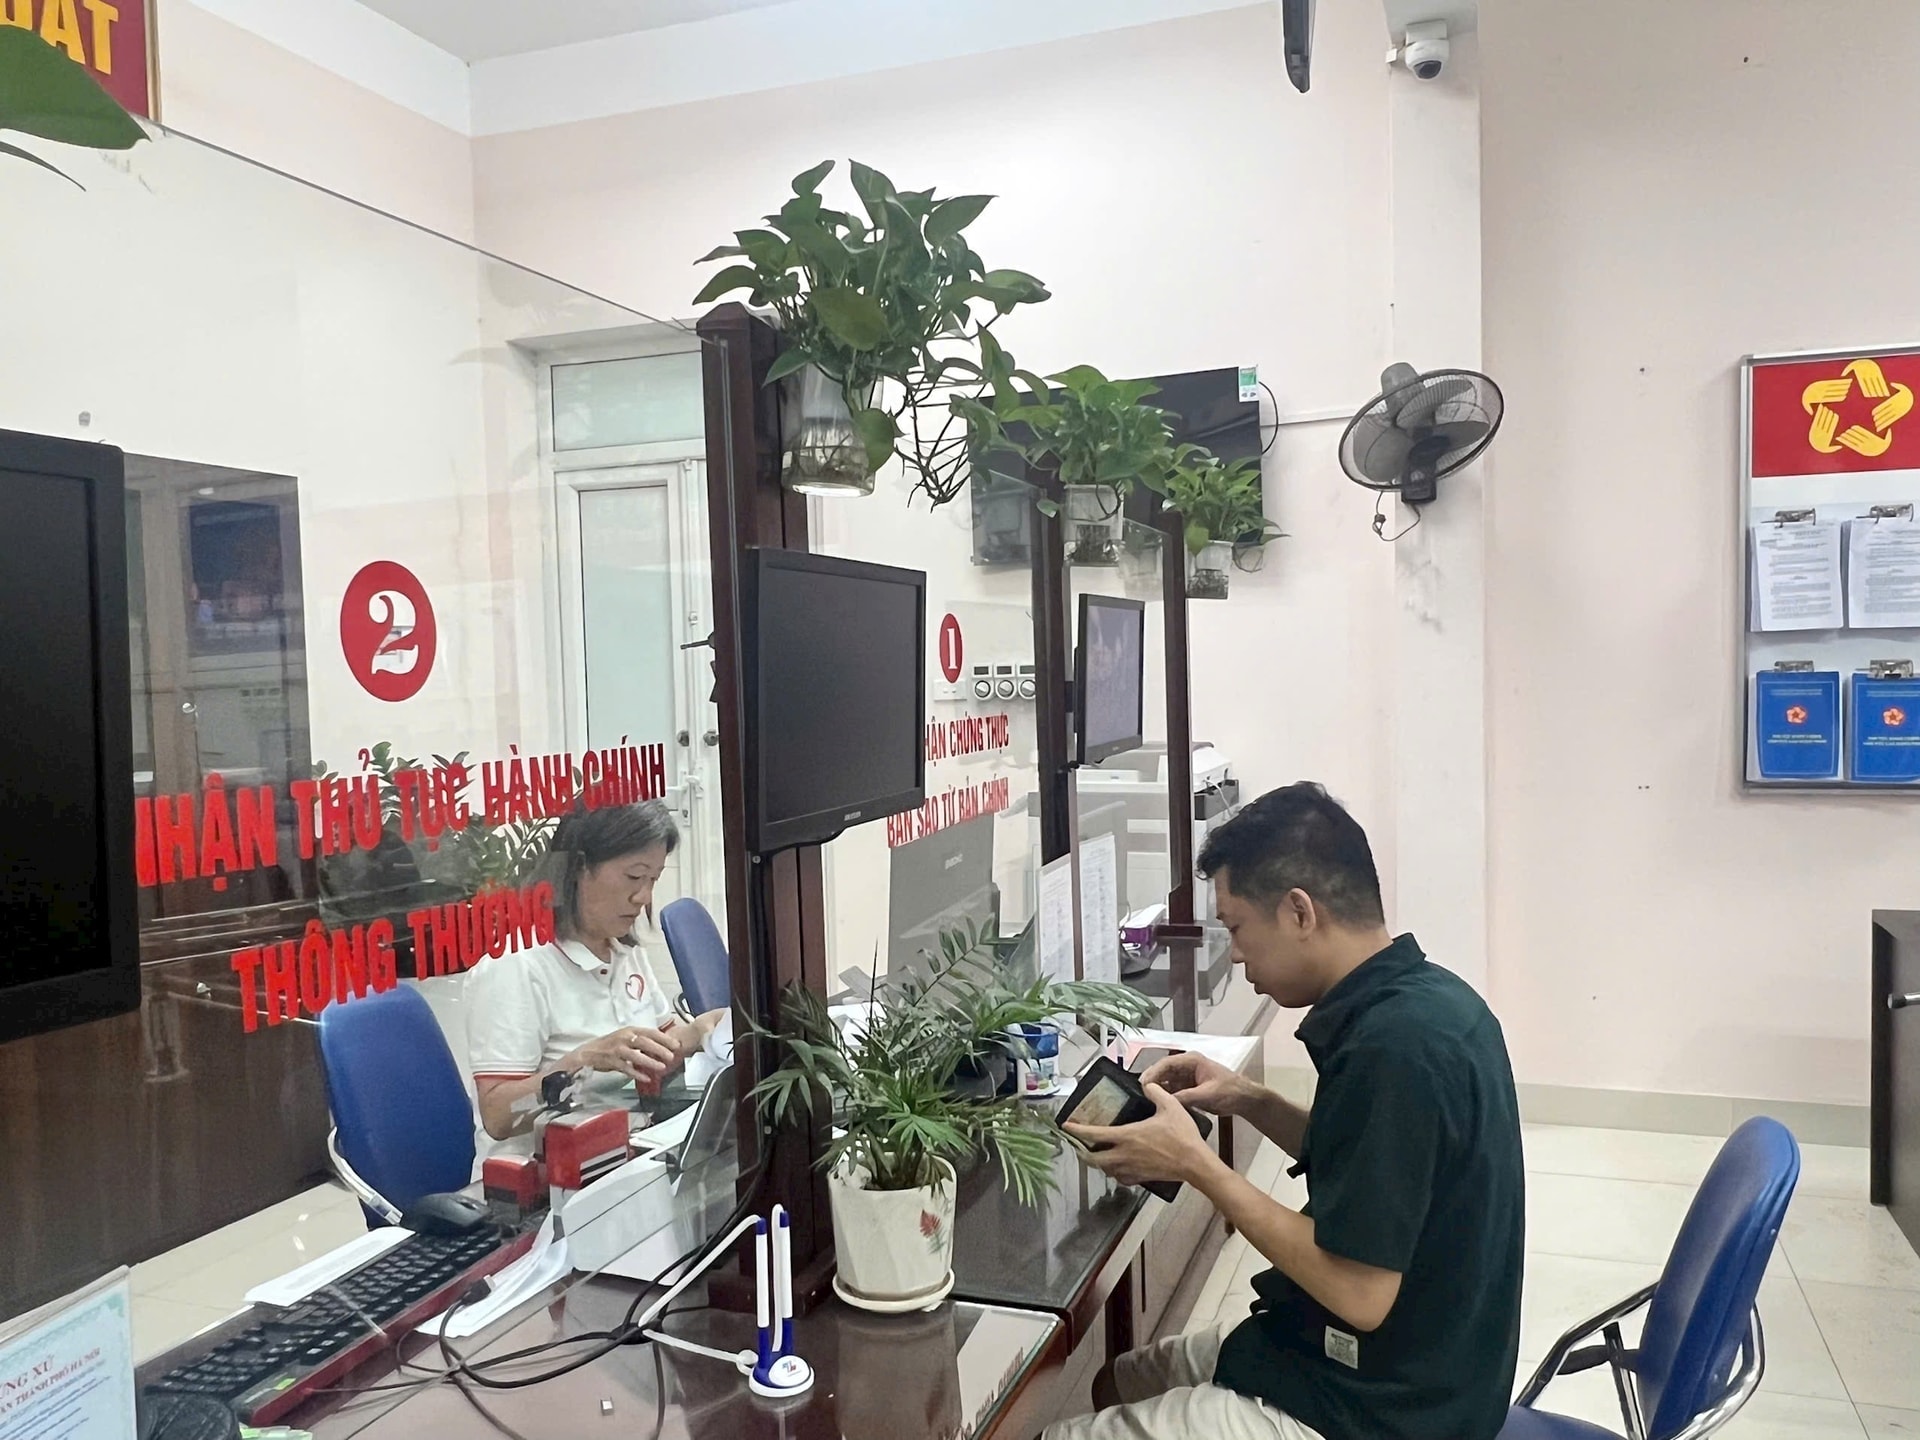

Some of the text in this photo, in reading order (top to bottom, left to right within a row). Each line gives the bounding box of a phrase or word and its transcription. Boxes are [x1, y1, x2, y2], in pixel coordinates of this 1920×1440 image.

[369, 590, 419, 675] 2
[947, 627, 958, 670] 1
[924, 711, 1010, 767] HẬN CHỨNG THỰC
[290, 748, 382, 859] THỦ
[394, 762, 470, 852] TỤC
[482, 744, 575, 827] HÀNH
[582, 735, 666, 812] CHÍNH
[958, 775, 979, 822] BẢN
[982, 773, 1009, 814] CHÍNH
[231, 877, 557, 1033] THÔNG THƯỜNG
